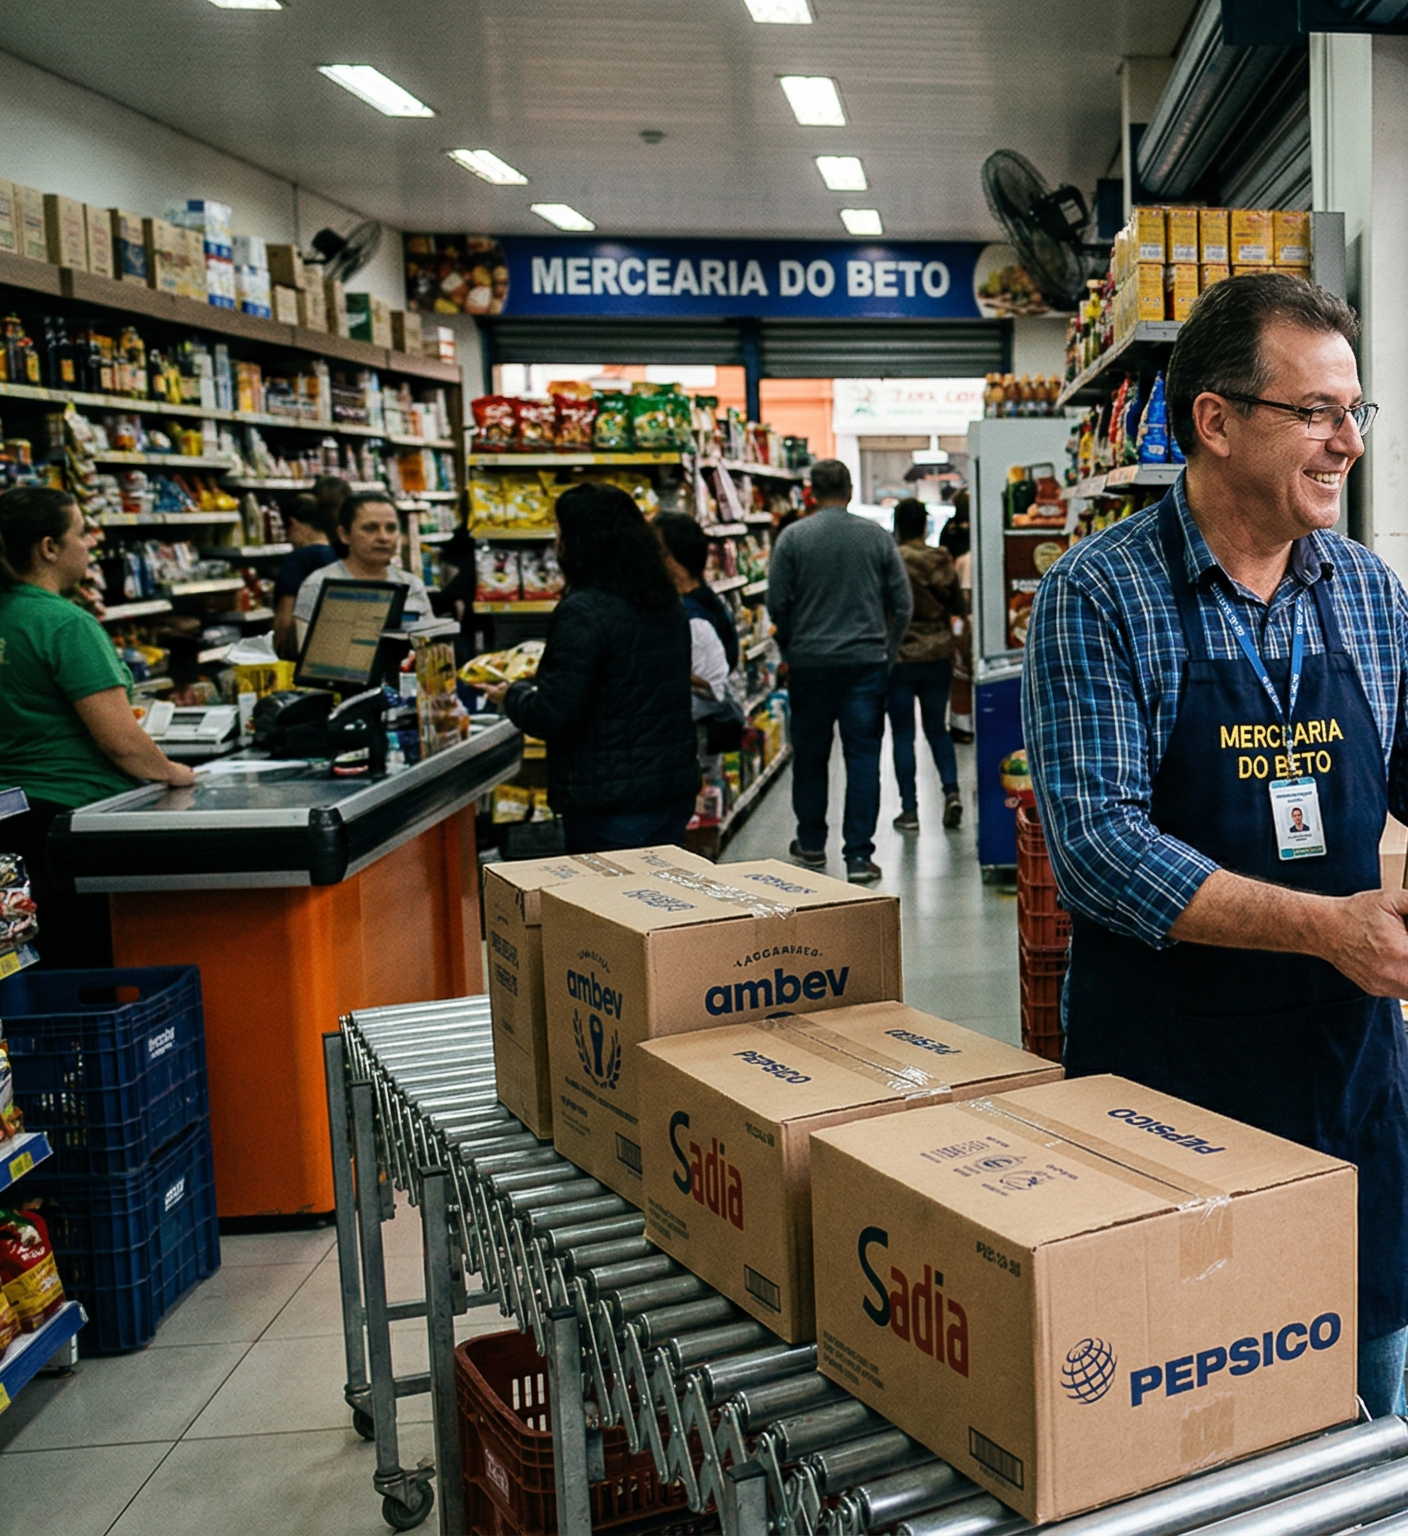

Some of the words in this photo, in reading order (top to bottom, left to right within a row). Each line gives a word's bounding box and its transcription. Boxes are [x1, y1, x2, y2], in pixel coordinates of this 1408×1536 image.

[531, 256, 768, 297] MERCEARIA
[779, 259, 836, 298] DO
[847, 260, 950, 299] BETO
[1238, 755, 1269, 779] DO
[566, 967, 623, 1021] ambev
[704, 966, 851, 1017] ambev
[1107, 1108, 1227, 1156] PEPSICO
[669, 1110, 744, 1231] Sadia
[857, 1225, 970, 1378] Sadia
[1130, 1311, 1343, 1408] PEPSICO
